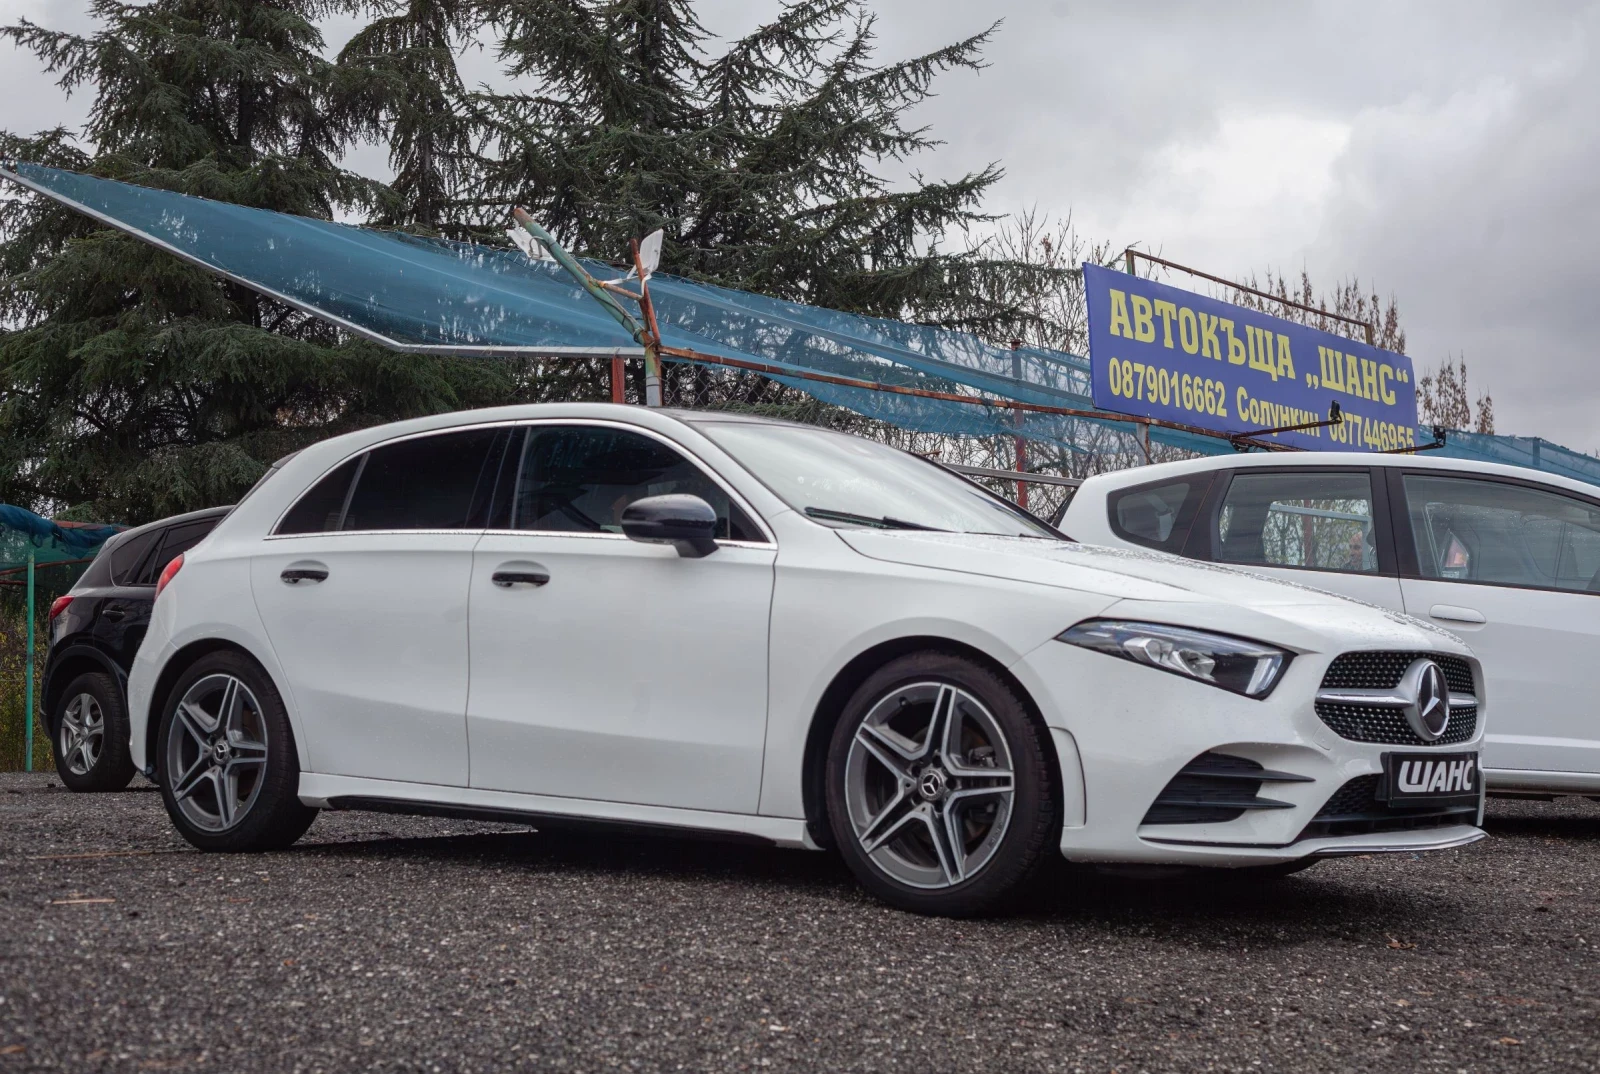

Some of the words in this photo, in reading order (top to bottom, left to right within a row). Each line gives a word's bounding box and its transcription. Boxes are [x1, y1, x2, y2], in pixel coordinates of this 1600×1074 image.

[1109, 288, 1296, 382] АВТОКЪЩА
[1108, 357, 1227, 418] 0879016662
[1236, 386, 1321, 438] Солункин
[1398, 760, 1474, 793] ШАНС
